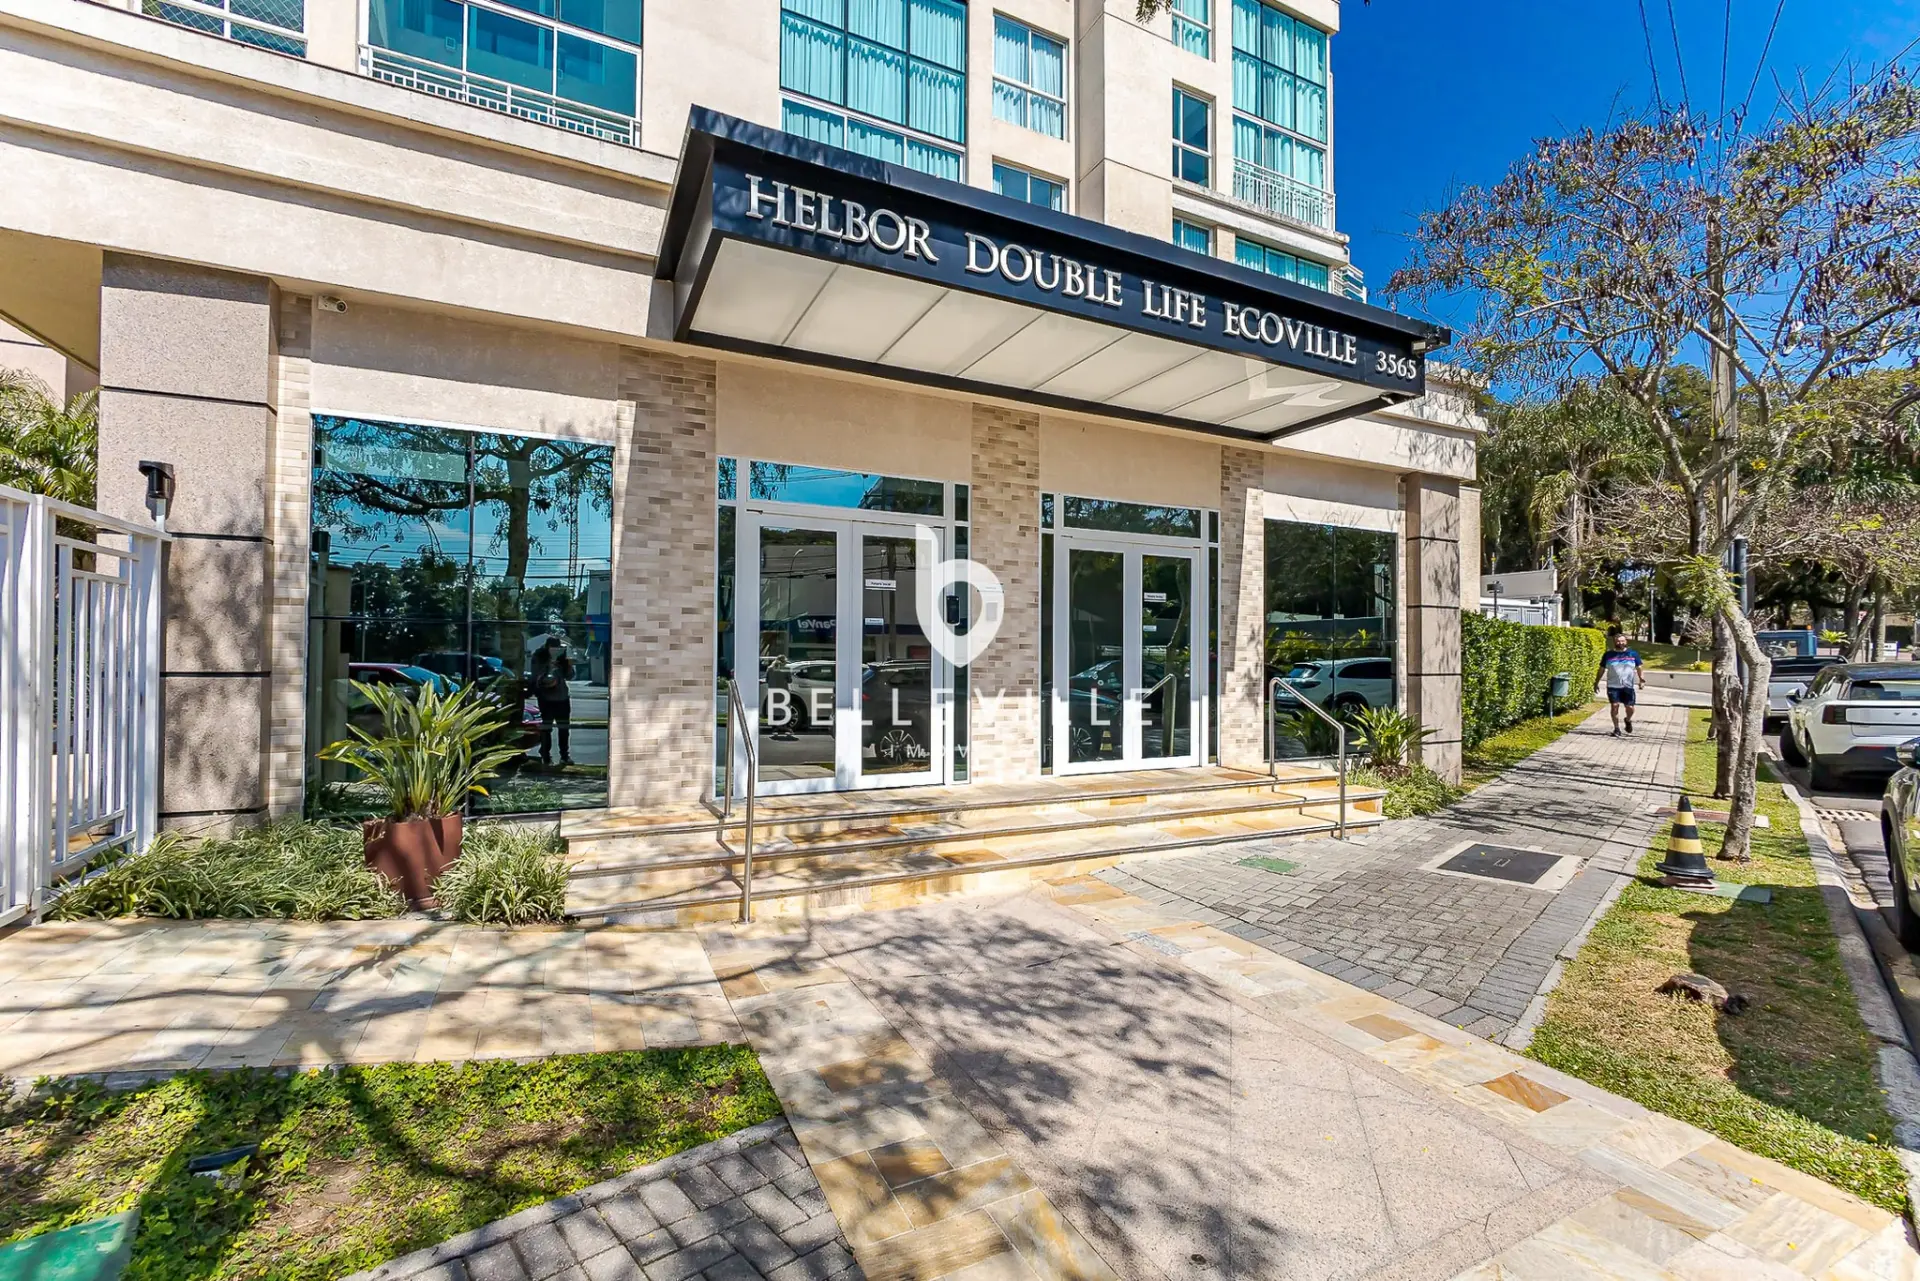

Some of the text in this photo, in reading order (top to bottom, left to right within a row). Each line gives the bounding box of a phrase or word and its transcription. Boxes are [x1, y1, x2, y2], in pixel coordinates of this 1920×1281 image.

[745, 173, 1417, 380] HELBOR DOUBLE LIFE ECOVILLE 3565
